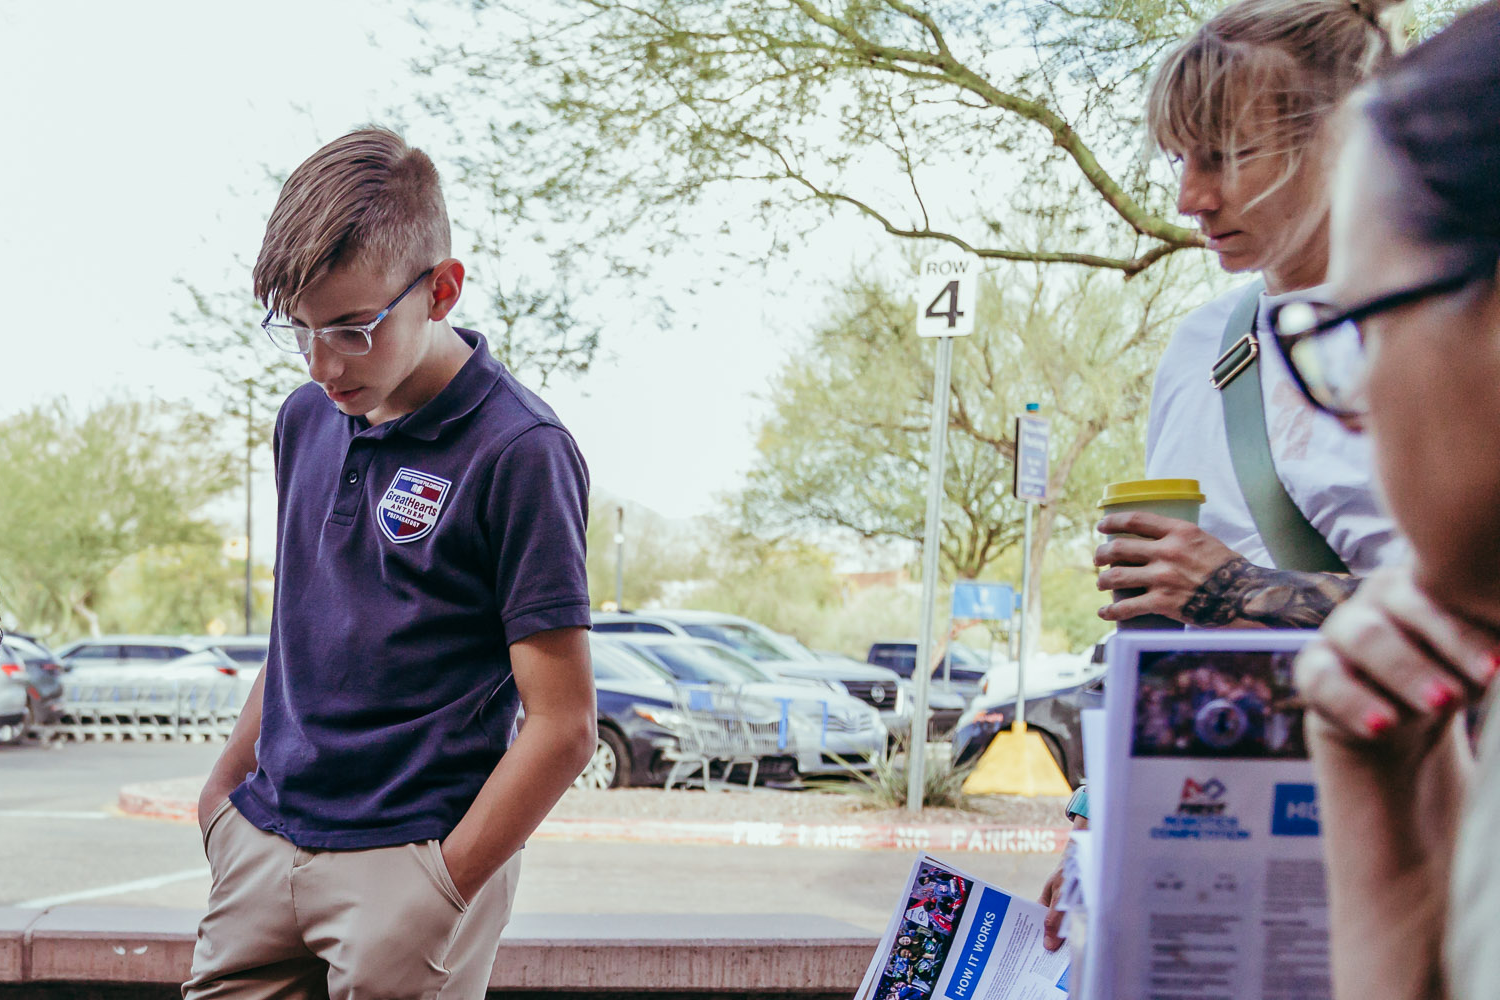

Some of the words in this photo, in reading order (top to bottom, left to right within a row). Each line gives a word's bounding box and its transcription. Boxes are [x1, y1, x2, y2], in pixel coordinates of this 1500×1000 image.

[926, 260, 969, 275] ROW
[925, 280, 964, 329] 4
[386, 490, 438, 517] GreatHearts
[391, 503, 425, 520] ANTHEM
[387, 511, 421, 528] PREPARATORY
[733, 821, 784, 846] FIRE
[895, 826, 931, 849] NO
[955, 967, 974, 997] HOW
[968, 953, 980, 967] IT
[974, 911, 996, 953] WORKS
